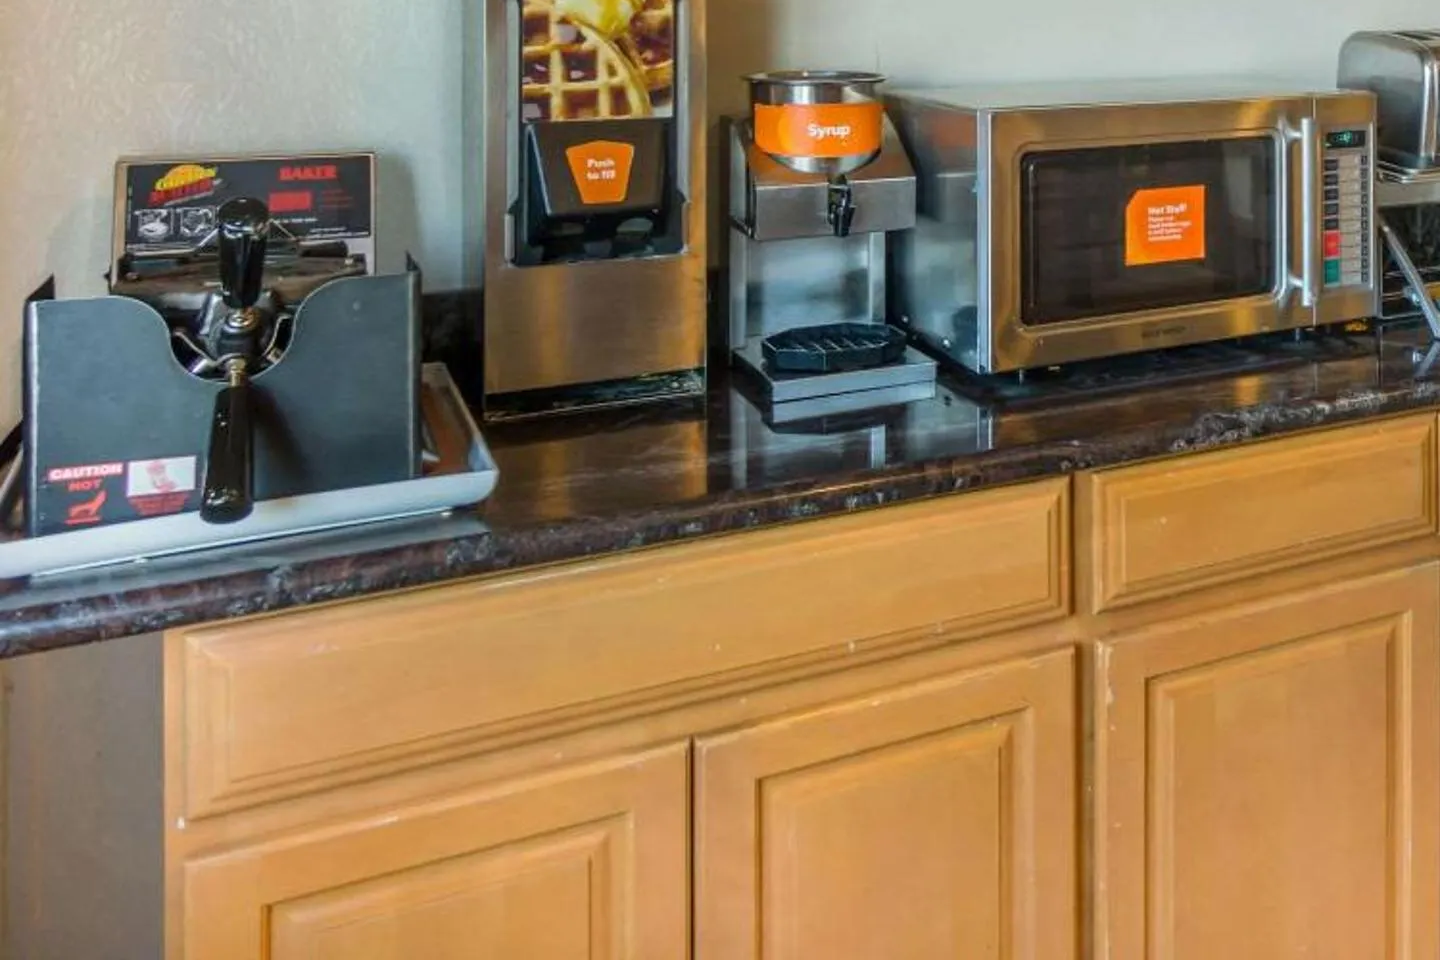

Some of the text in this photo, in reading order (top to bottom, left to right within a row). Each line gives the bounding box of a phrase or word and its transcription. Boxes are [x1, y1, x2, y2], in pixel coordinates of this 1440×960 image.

[807, 122, 851, 141] Syrup
[48, 462, 124, 482] CAUTION
[68, 479, 102, 492] HOT
